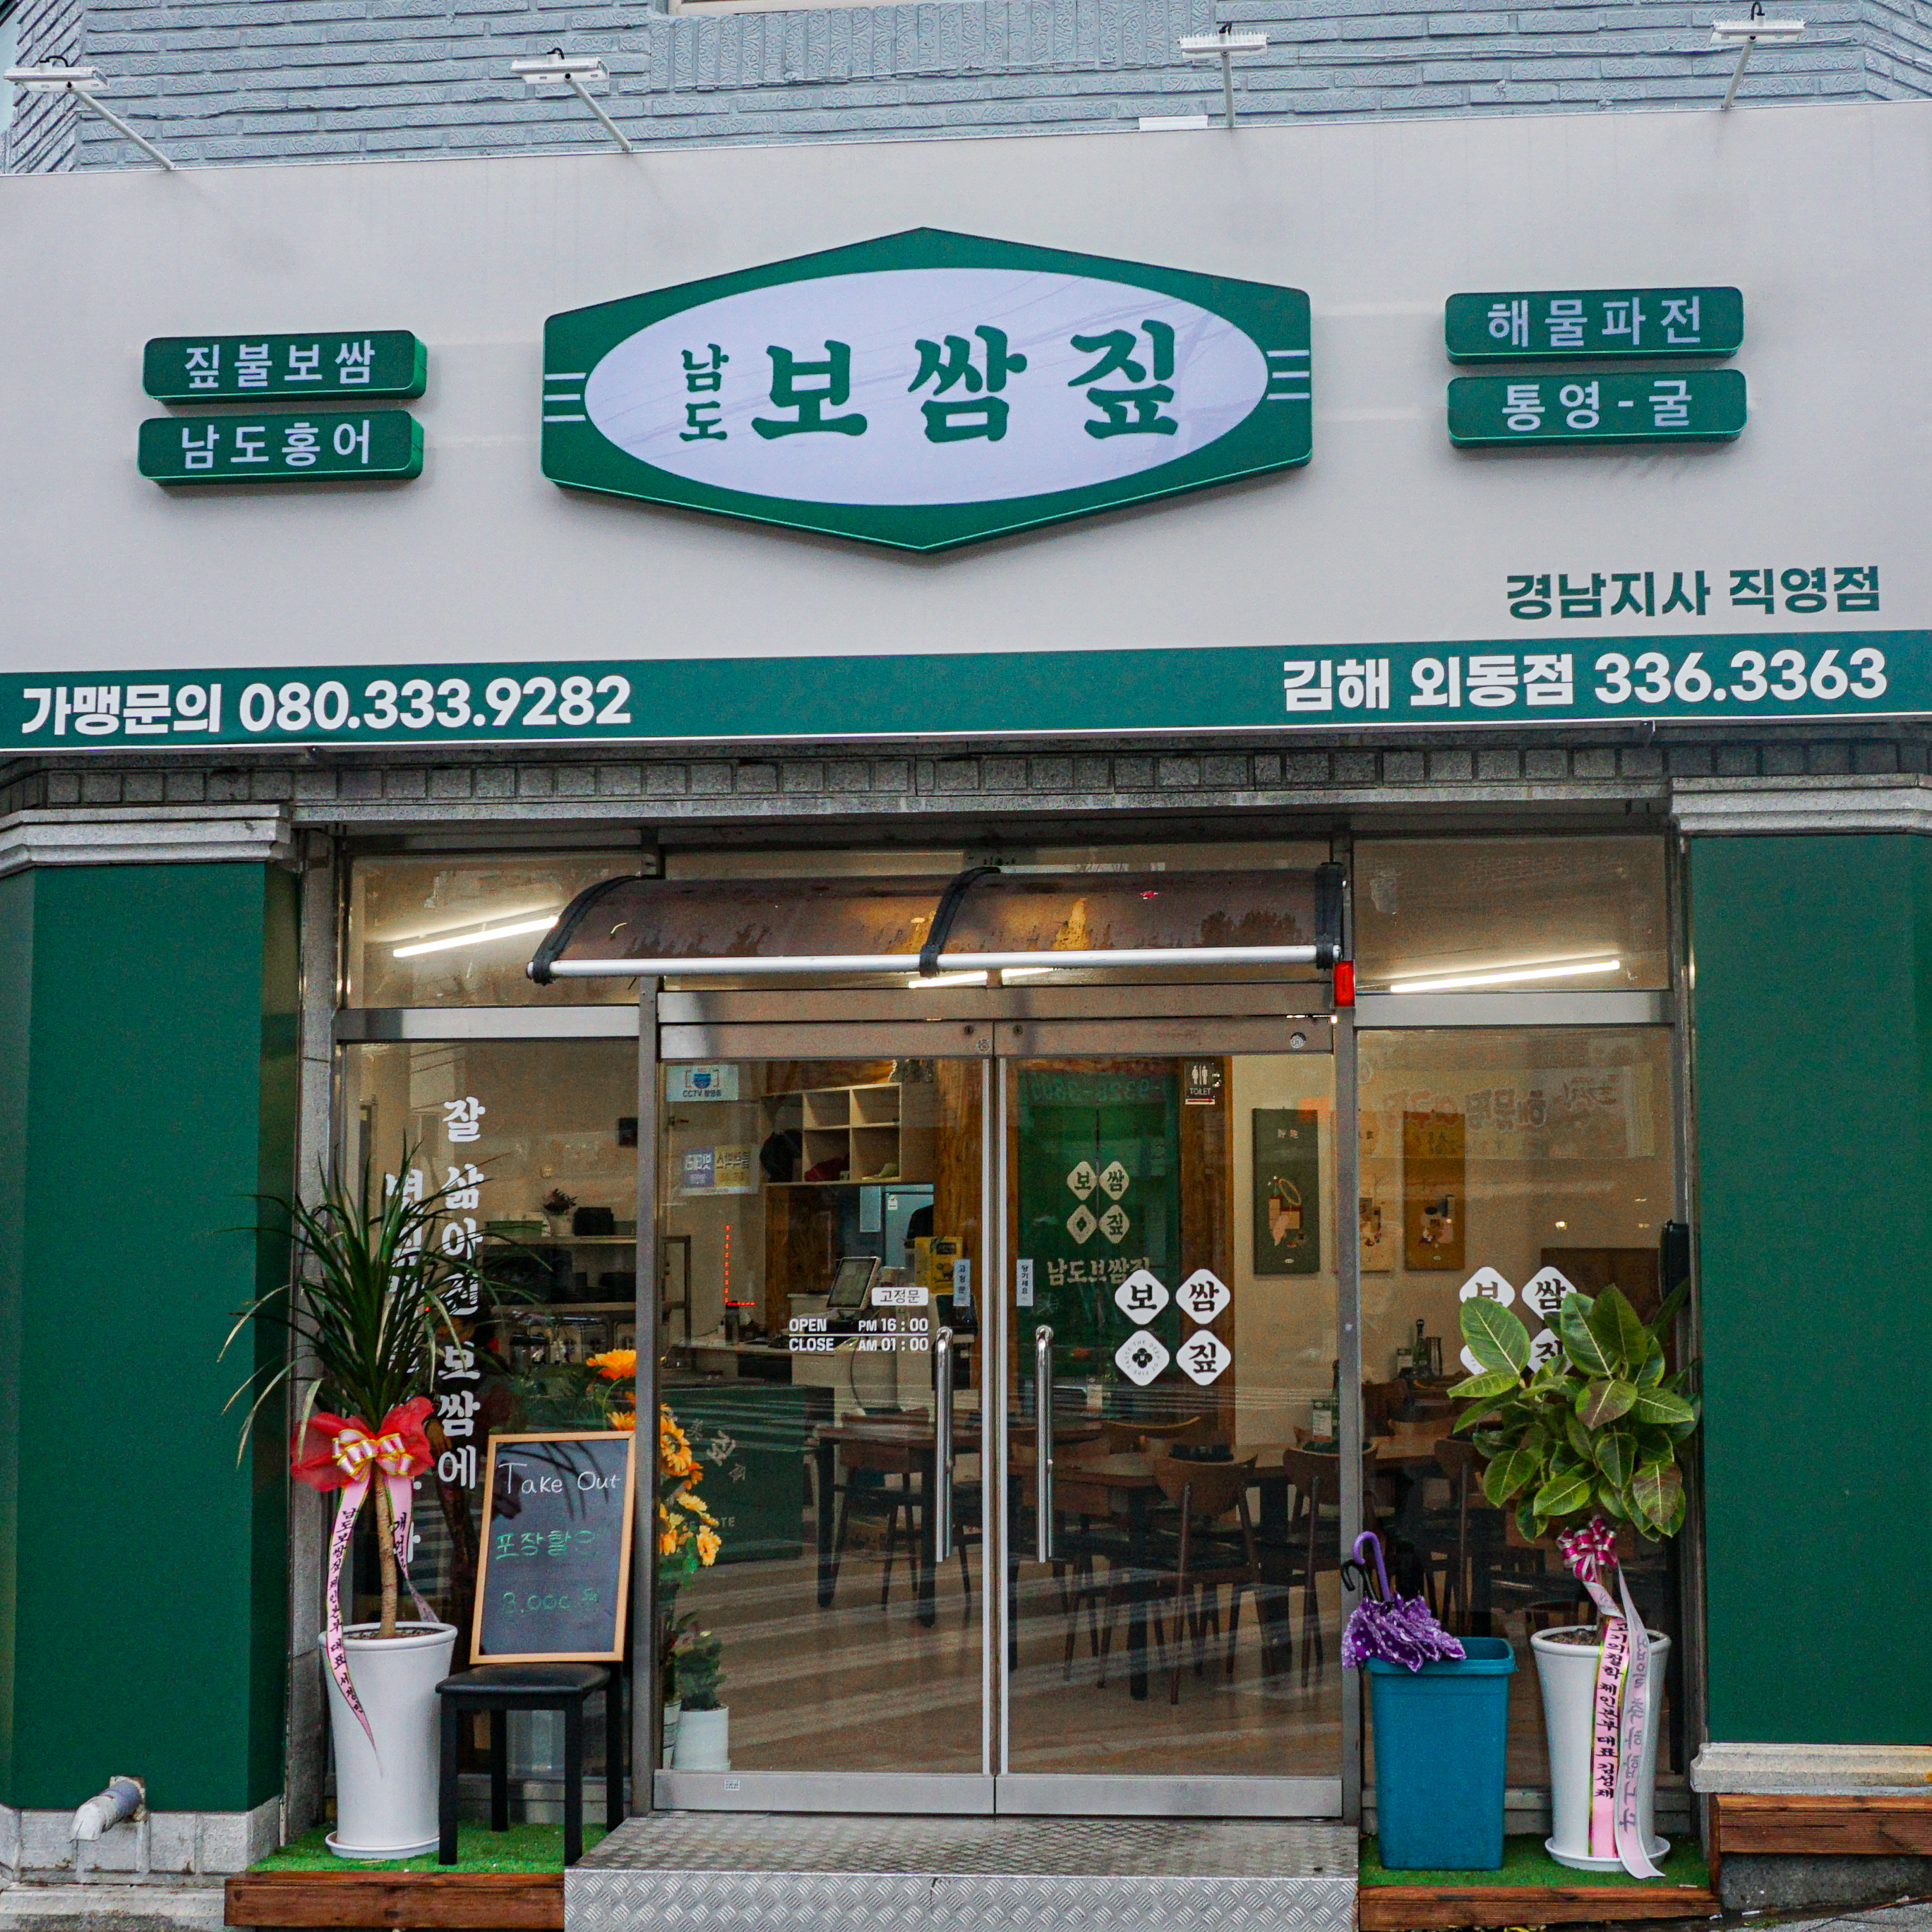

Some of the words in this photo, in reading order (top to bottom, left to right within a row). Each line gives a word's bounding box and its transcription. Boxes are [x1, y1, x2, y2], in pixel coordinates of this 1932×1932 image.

[1487, 295, 1702, 348] 해물파전
[184, 339, 376, 389] 짚불보쌈
[750, 318, 1180, 443] 보쌈짚
[678, 343, 729, 443] 남도
[1501, 380, 1693, 432] 통영-굴
[181, 419, 371, 469] 남도홍어
[1506, 570, 1711, 620] 경남지사
[1729, 565, 1880, 615] 직영점
[1283, 658, 1390, 712] 김해
[1410, 654, 1575, 707] 외동점
[1593, 648, 1888, 702] 336.3363
[22, 683, 223, 736] 가맹문의
[239, 675, 632, 733] 080.333.9282
[442, 1096, 486, 1142] 잘
[1074, 1171, 1092, 1190] 보
[1107, 1169, 1125, 1192] 쌈
[880, 1289, 920, 1304] 고정문
[1127, 1283, 1158, 1311] 보
[1189, 1280, 1219, 1313] 쌈
[1535, 1278, 1566, 1310] 쌈
[788, 1318, 827, 1332] OPEN
[858, 1320, 877, 1332] PM
[788, 1338, 835, 1352] CLOSE
[857, 1339, 877, 1352] AM
[1189, 1342, 1219, 1375] 짚
[437, 1340, 481, 1489] 보쌈에
[498, 1462, 563, 1495] Take
[577, 1470, 621, 1492] Out
